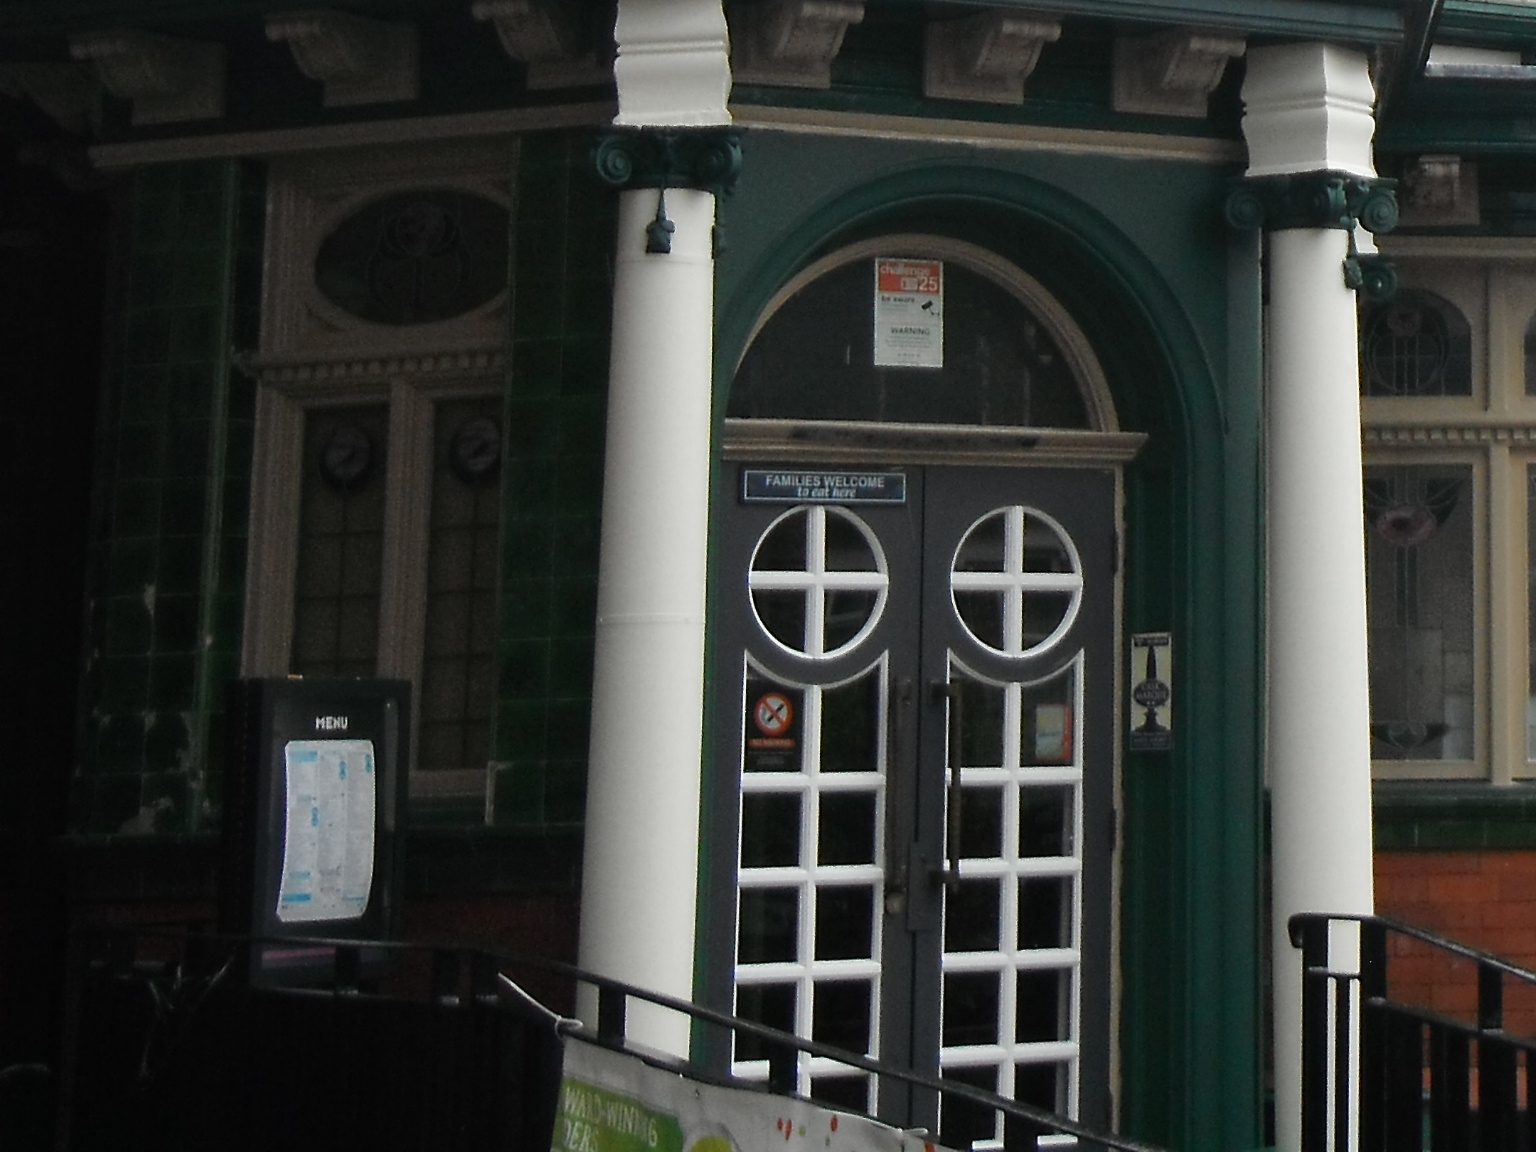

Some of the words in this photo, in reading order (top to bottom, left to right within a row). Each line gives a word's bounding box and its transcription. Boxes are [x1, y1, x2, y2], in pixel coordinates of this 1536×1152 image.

[918, 275, 939, 291] 25
[890, 326, 931, 336] WARNING
[765, 474, 821, 487] FAMILIES
[823, 475, 885, 488] WELCOME
[797, 487, 810, 497] to
[811, 487, 830, 498] eat
[832, 487, 856, 498] here
[315, 716, 348, 730] MENU
